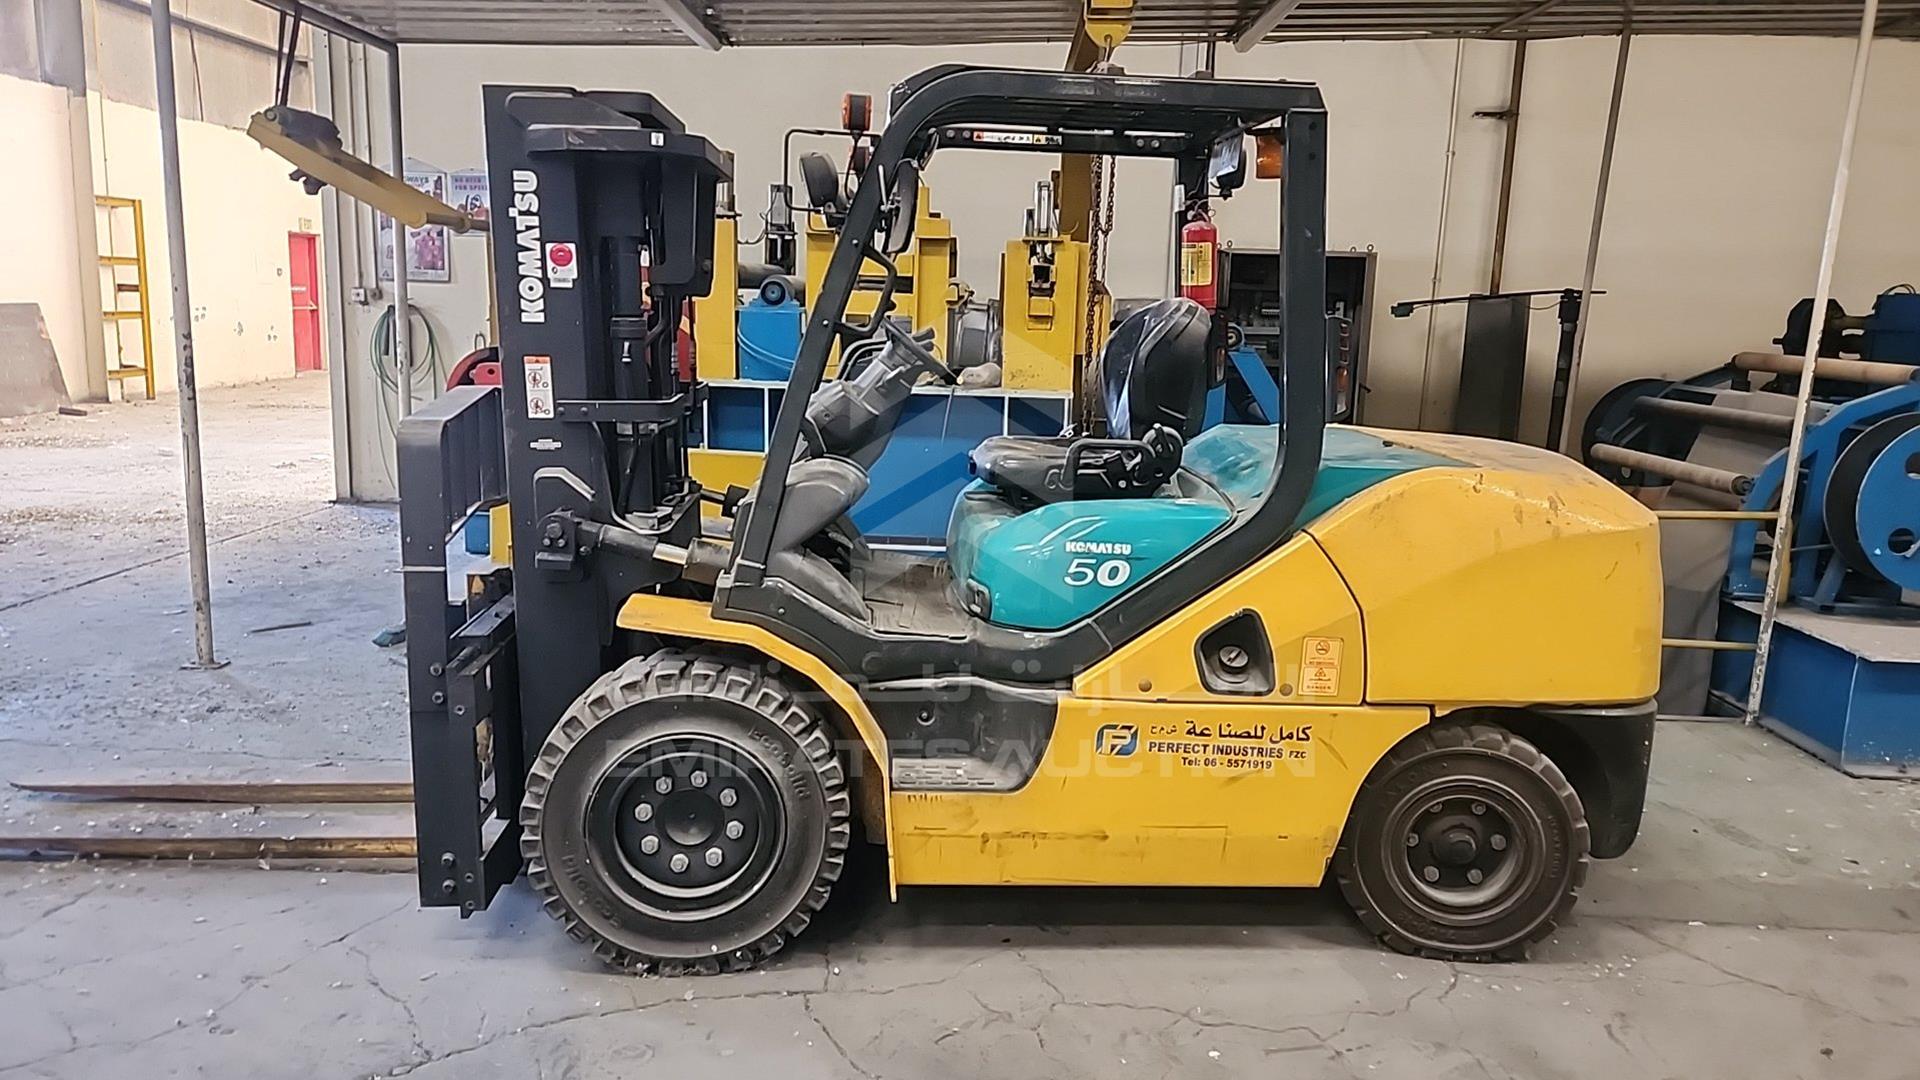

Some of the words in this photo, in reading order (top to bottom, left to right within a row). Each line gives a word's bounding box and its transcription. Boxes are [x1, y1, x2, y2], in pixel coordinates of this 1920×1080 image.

[508, 169, 545, 323] KOMATSU
[1065, 541, 1132, 556] KOMATSU
[1063, 558, 1131, 587] 50
[1185, 720, 1267, 740] للصناعة
[1269, 724, 1313, 744] كامل
[1148, 741, 1210, 754] PERFECT
[1211, 744, 1284, 758] INDUSTRIES
[1288, 750, 1307, 759] FZC
[1180, 756, 1201, 766] Tel:
[1203, 757, 1217, 767] 06
[1226, 758, 1273, 769] 5571919
